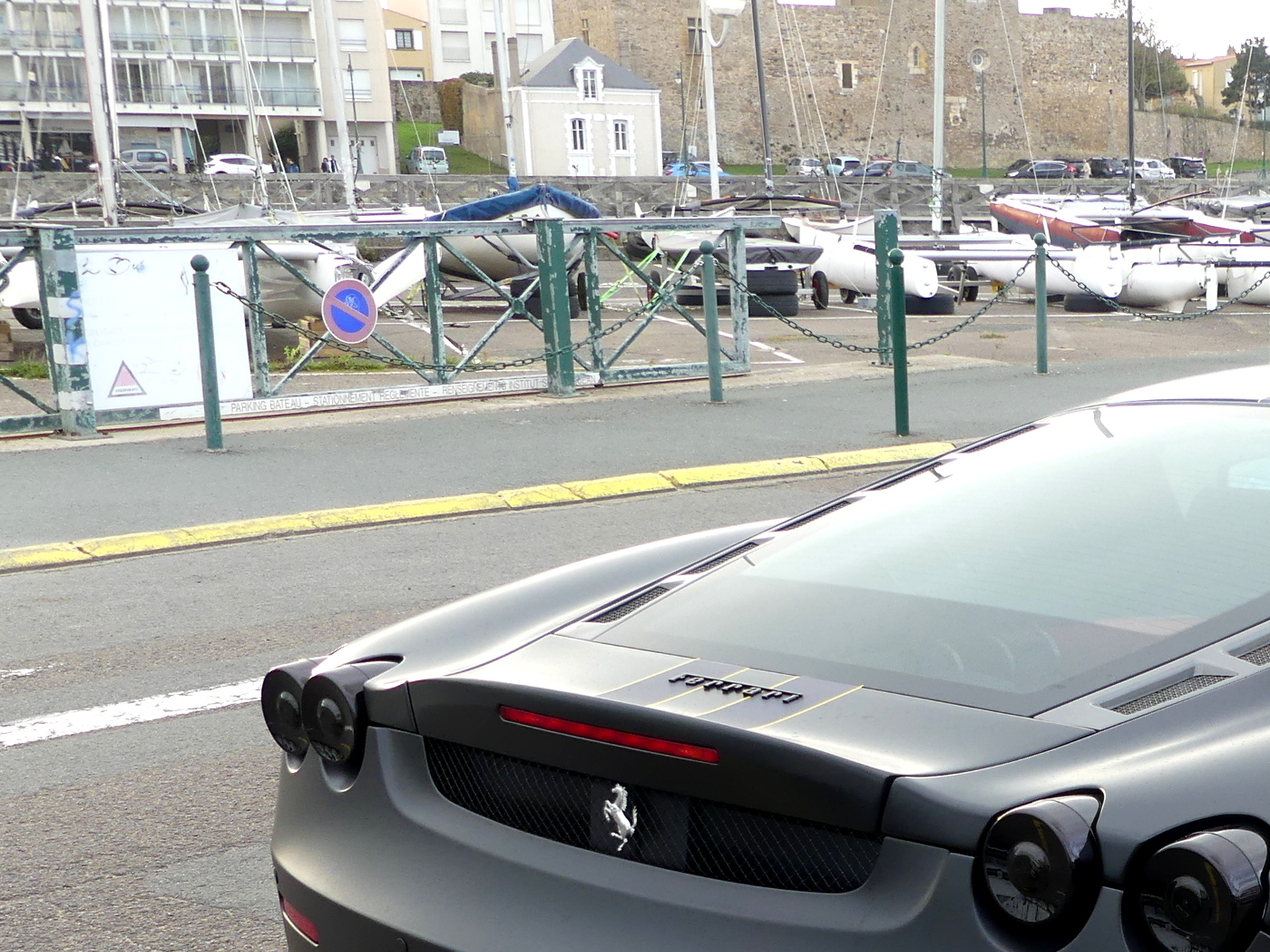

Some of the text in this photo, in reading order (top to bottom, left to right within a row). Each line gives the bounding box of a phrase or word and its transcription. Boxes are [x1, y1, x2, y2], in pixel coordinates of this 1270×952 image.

[230, 400, 267, 413] PARKING
[269, 397, 302, 411] BATEAU
[313, 391, 379, 406] STATIONNEMENT
[508, 378, 542, 391] INSTITUT
[668, 672, 805, 704] Ferrari
